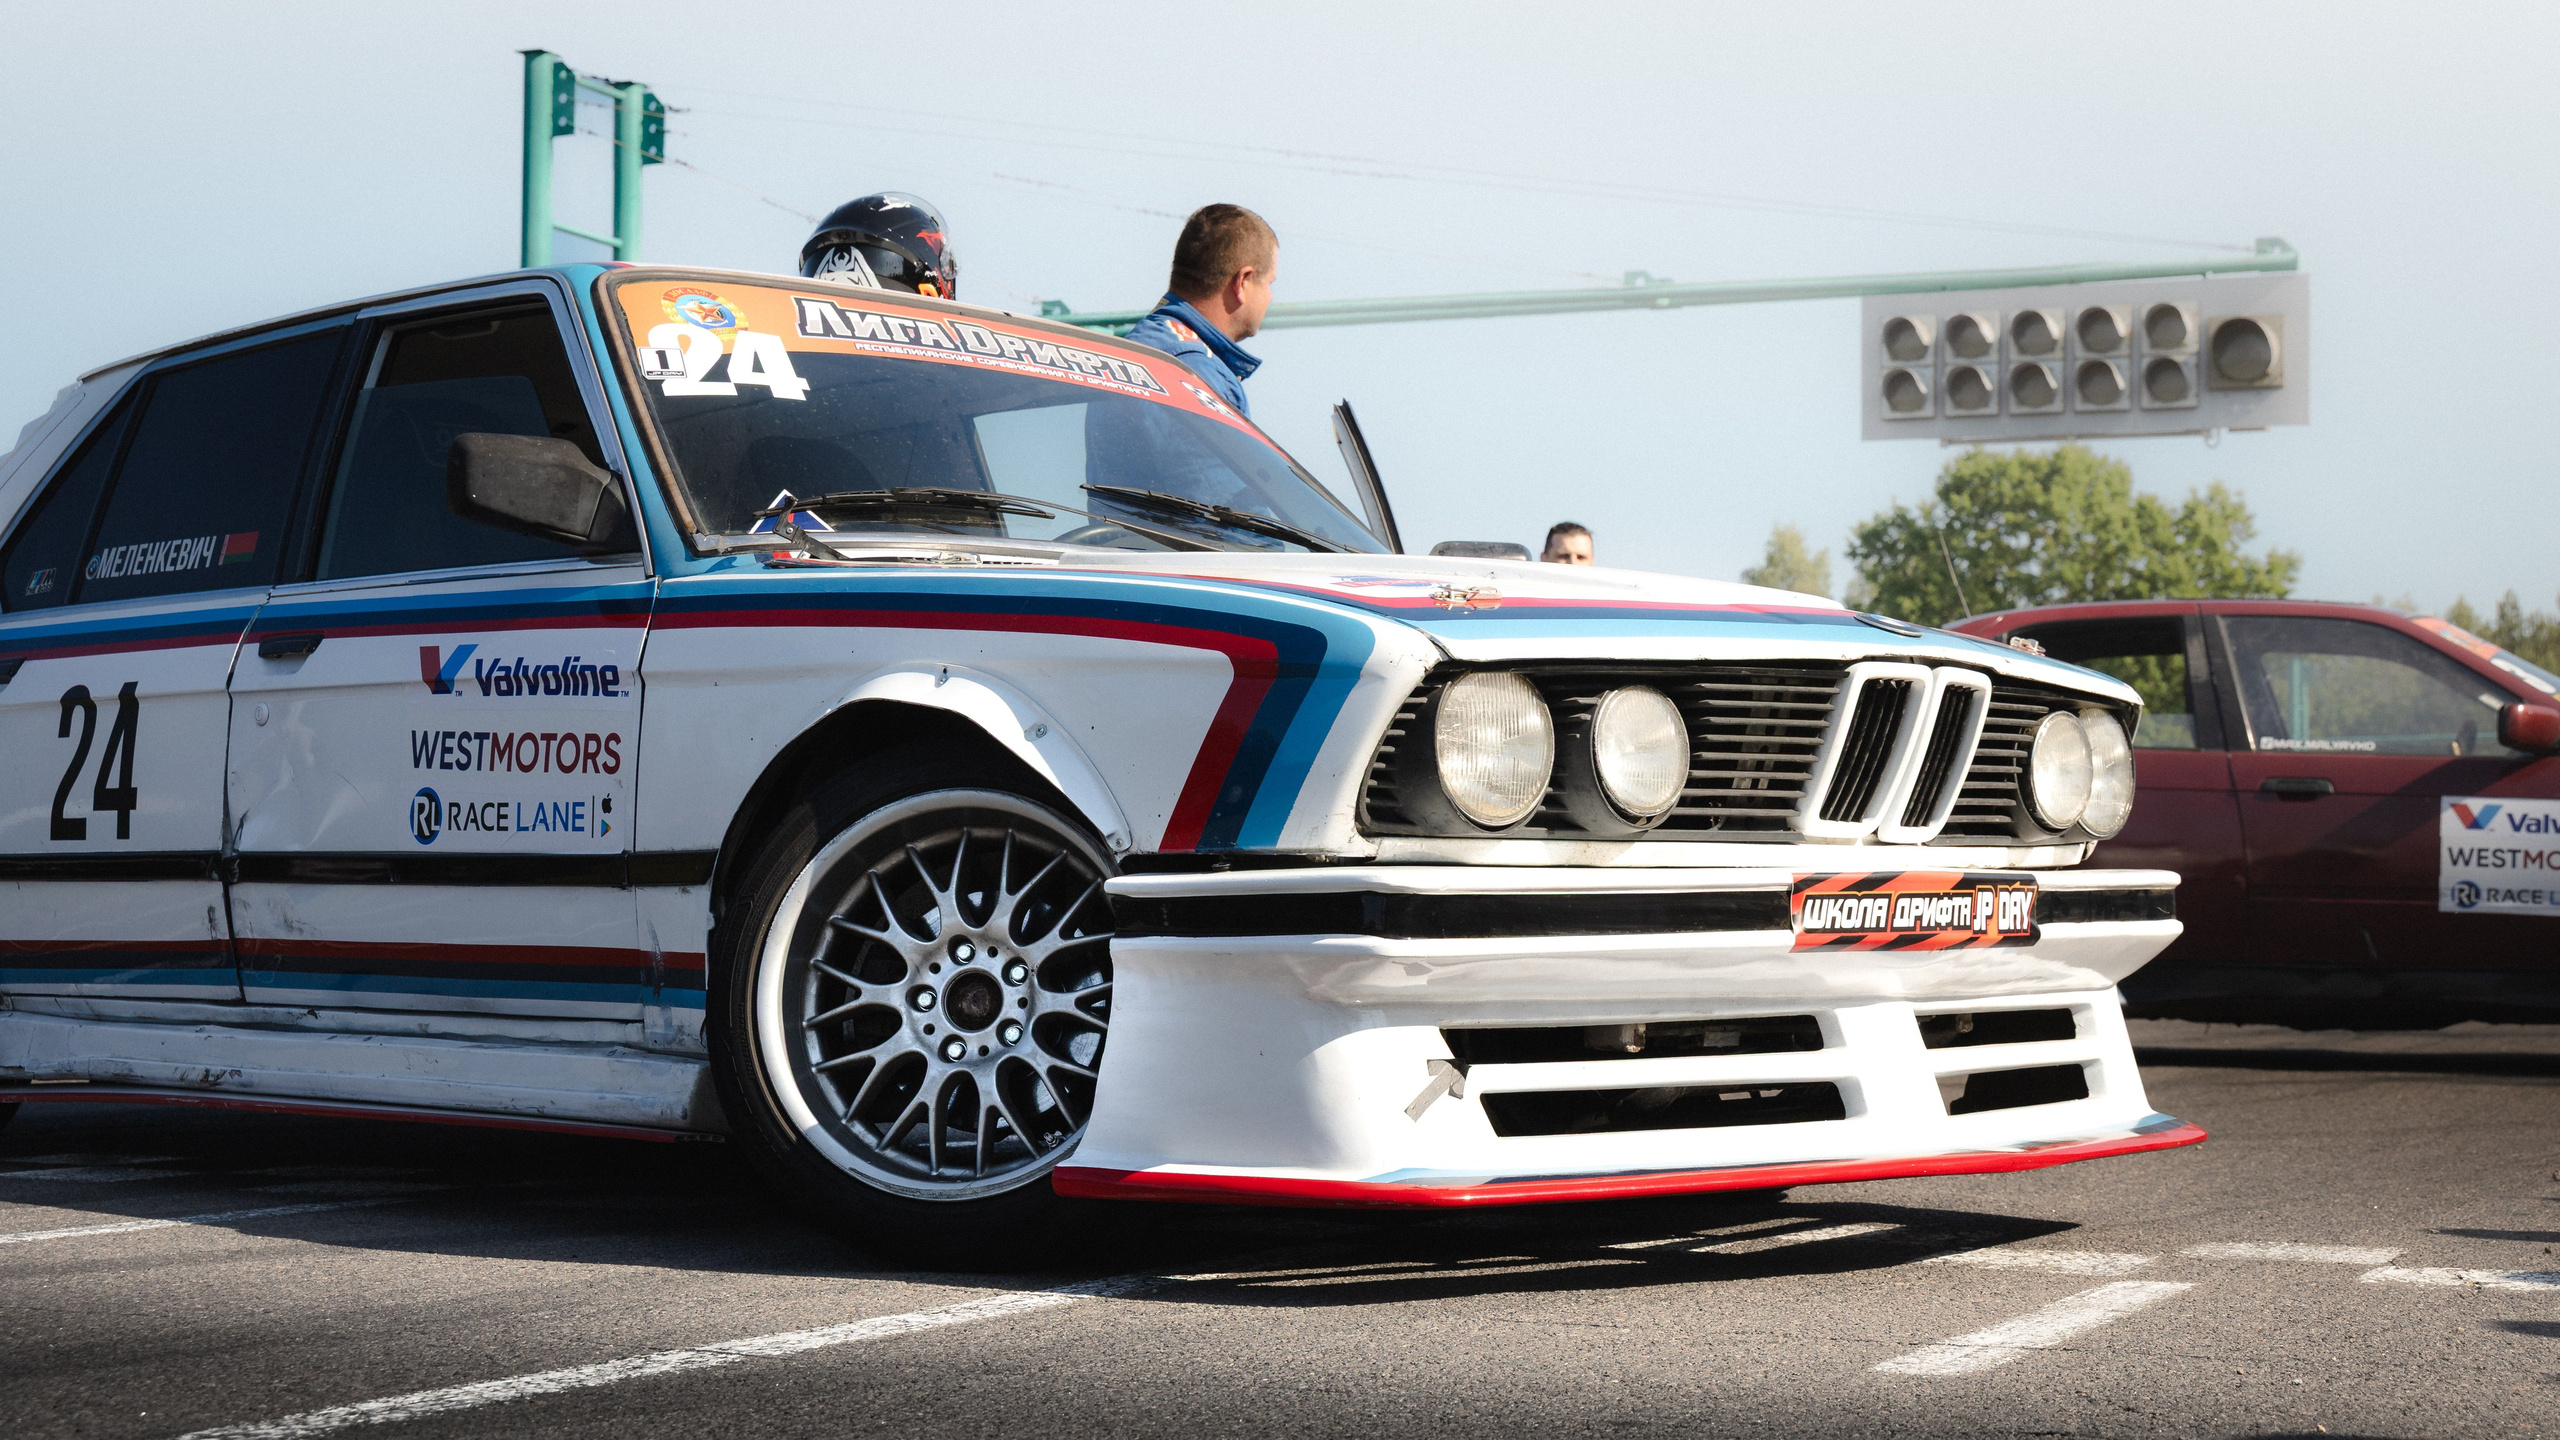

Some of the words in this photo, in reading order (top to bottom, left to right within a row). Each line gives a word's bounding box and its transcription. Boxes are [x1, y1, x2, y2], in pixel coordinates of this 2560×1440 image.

[648, 323, 811, 401] 24
[655, 350, 670, 370] 1
[855, 343, 975, 363] РЕСПУБЛИКАНСКИЕ
[976, 358, 1066, 378] СОРЕВНОВАНИЯ
[1068, 373, 1084, 382] ПО
[1086, 377, 1151, 397] ДРИФТИНГУ
[96, 535, 217, 579] МЕЛЕНКЕВИЧ
[475, 656, 620, 697] Valvoline
[50, 681, 139, 841] 24
[411, 729, 622, 775] WESTMOTORS
[448, 802, 509, 831] RACE
[516, 801, 586, 832] LANE
[1803, 897, 1890, 929] ШКОЛА
[1893, 896, 1972, 928] ДРИФТА
[1973, 891, 1993, 931] JP
[1998, 891, 2033, 931] DAY
[2486, 887, 2543, 905] RACE
